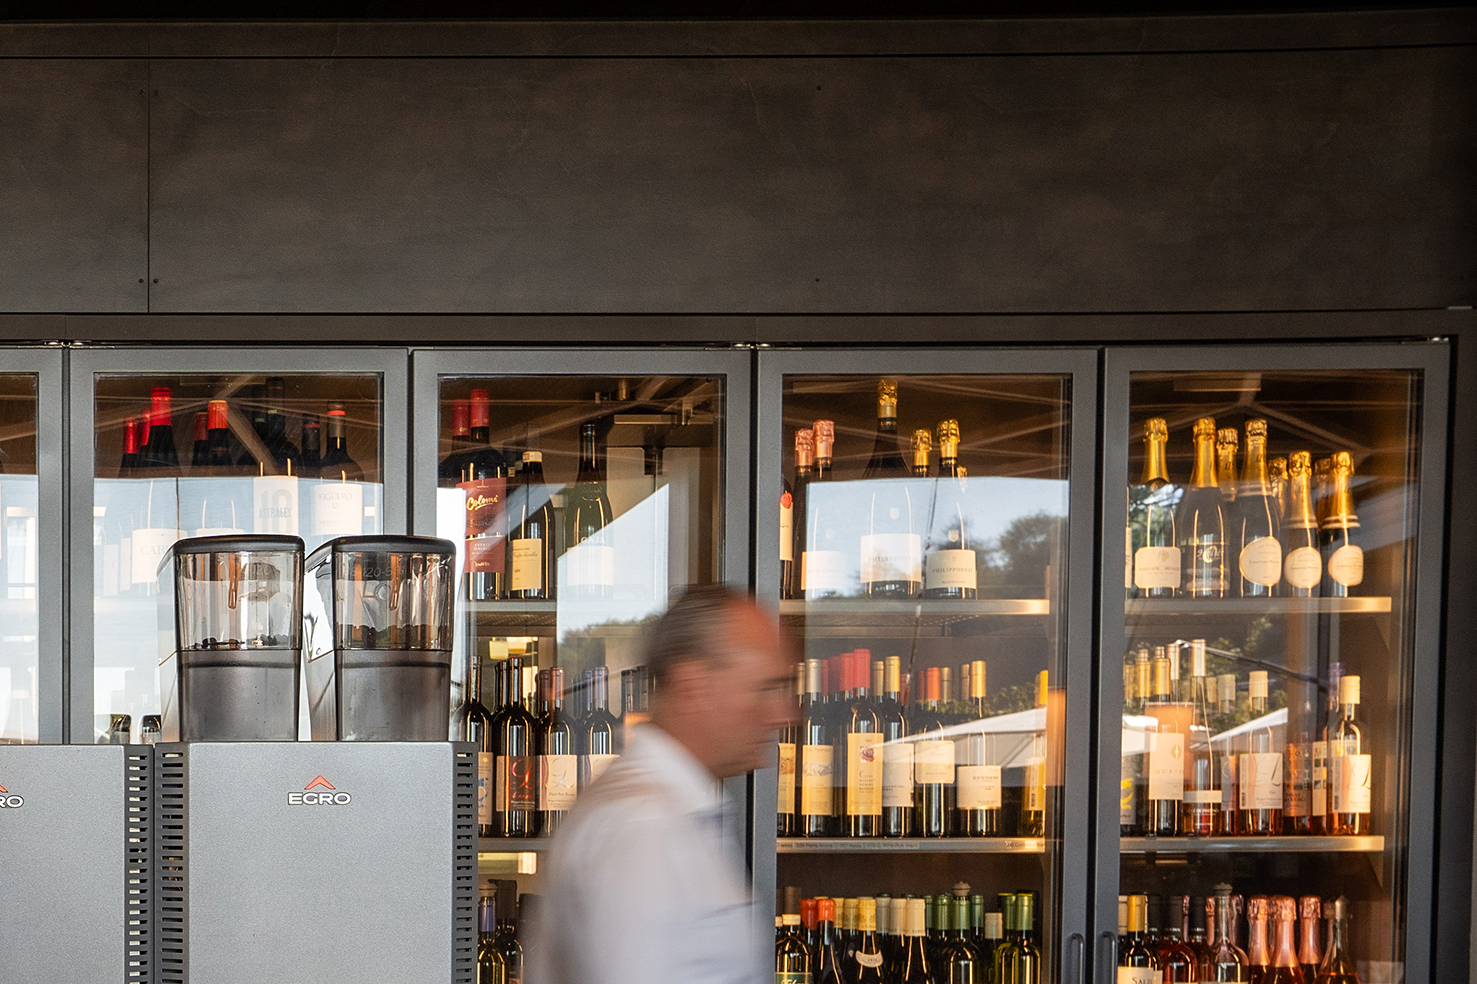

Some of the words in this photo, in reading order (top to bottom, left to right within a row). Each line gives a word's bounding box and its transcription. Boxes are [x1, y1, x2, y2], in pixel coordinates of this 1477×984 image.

[318, 493, 353, 501] FIGUERO
[258, 507, 292, 519] ASTRALES
[288, 792, 351, 805] EGRO
